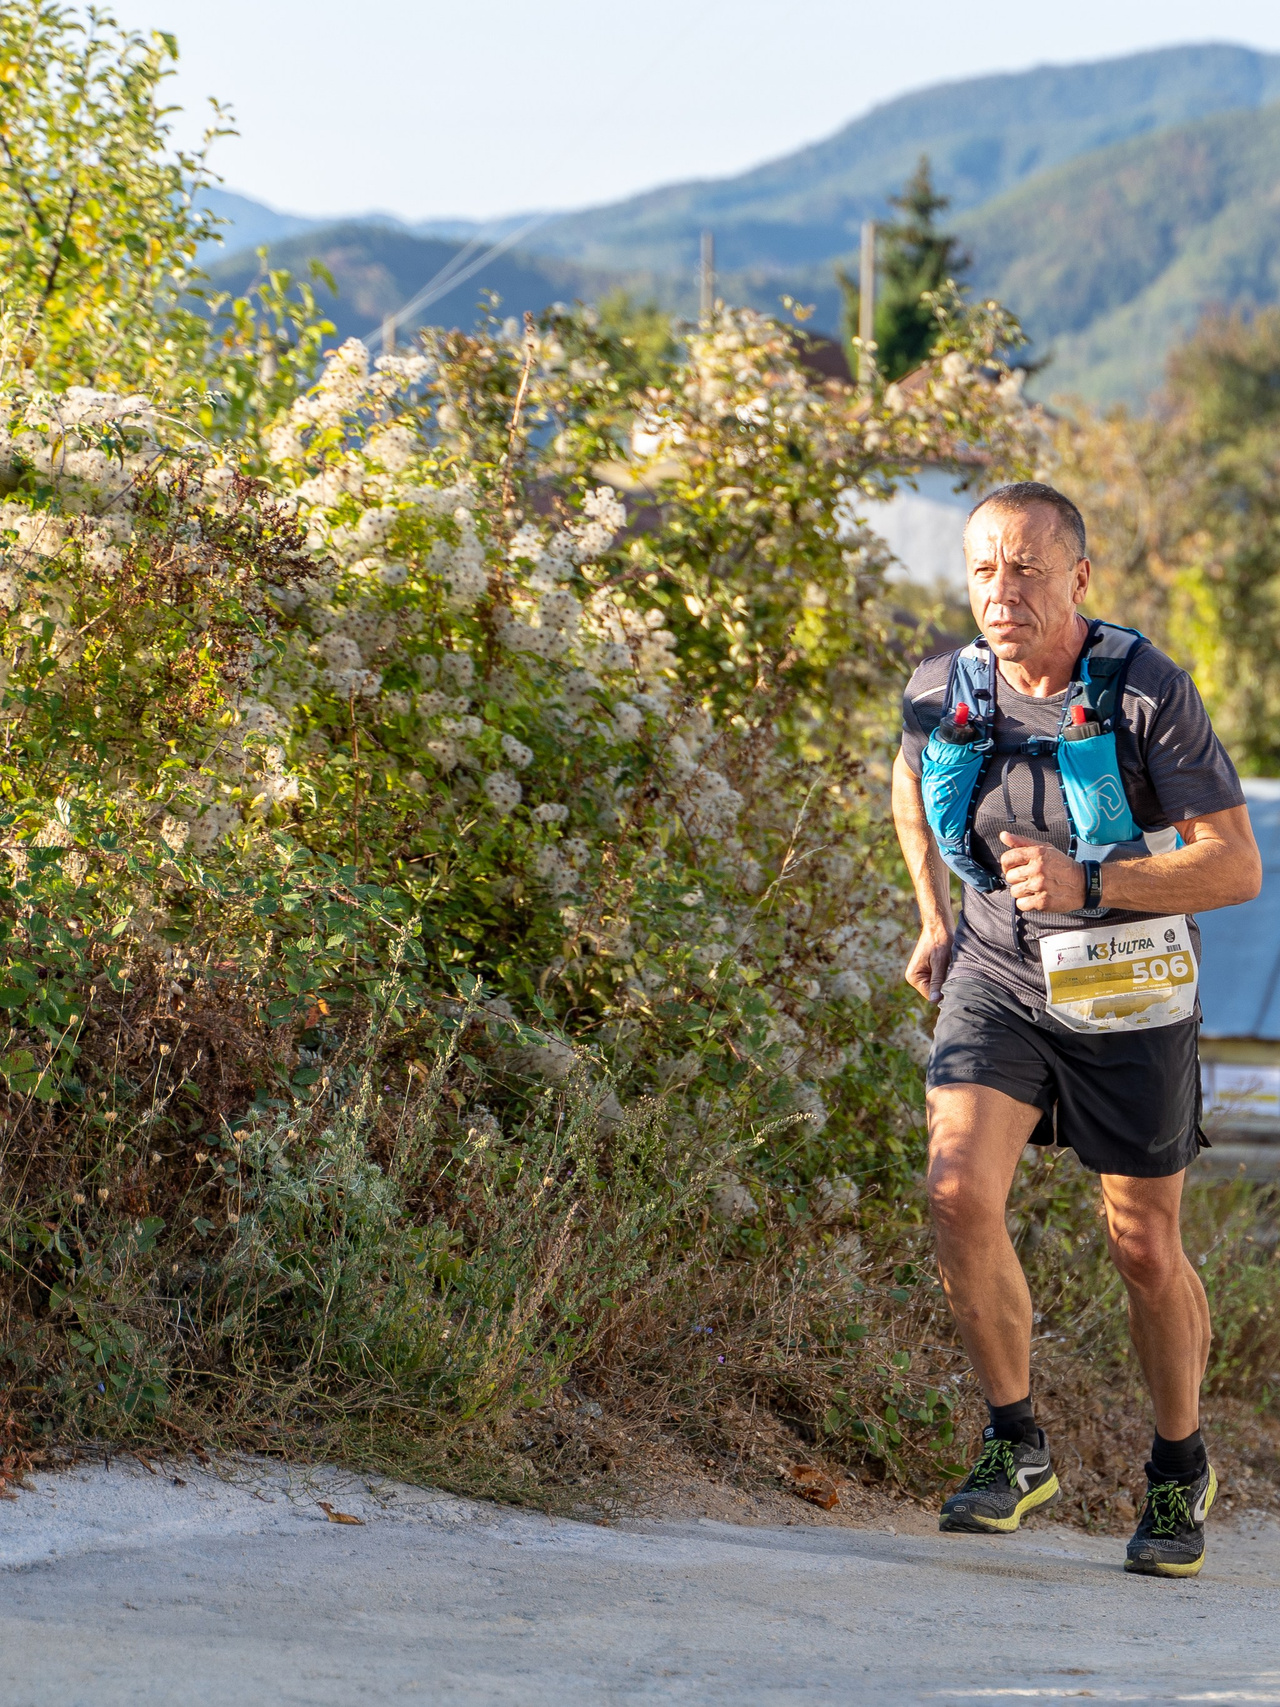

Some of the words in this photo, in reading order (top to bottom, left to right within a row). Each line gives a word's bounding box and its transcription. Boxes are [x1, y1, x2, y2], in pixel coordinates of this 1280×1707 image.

[1086, 943, 1109, 961] K3
[1118, 937, 1155, 955] ULTRA
[1132, 955, 1189, 984] 506
